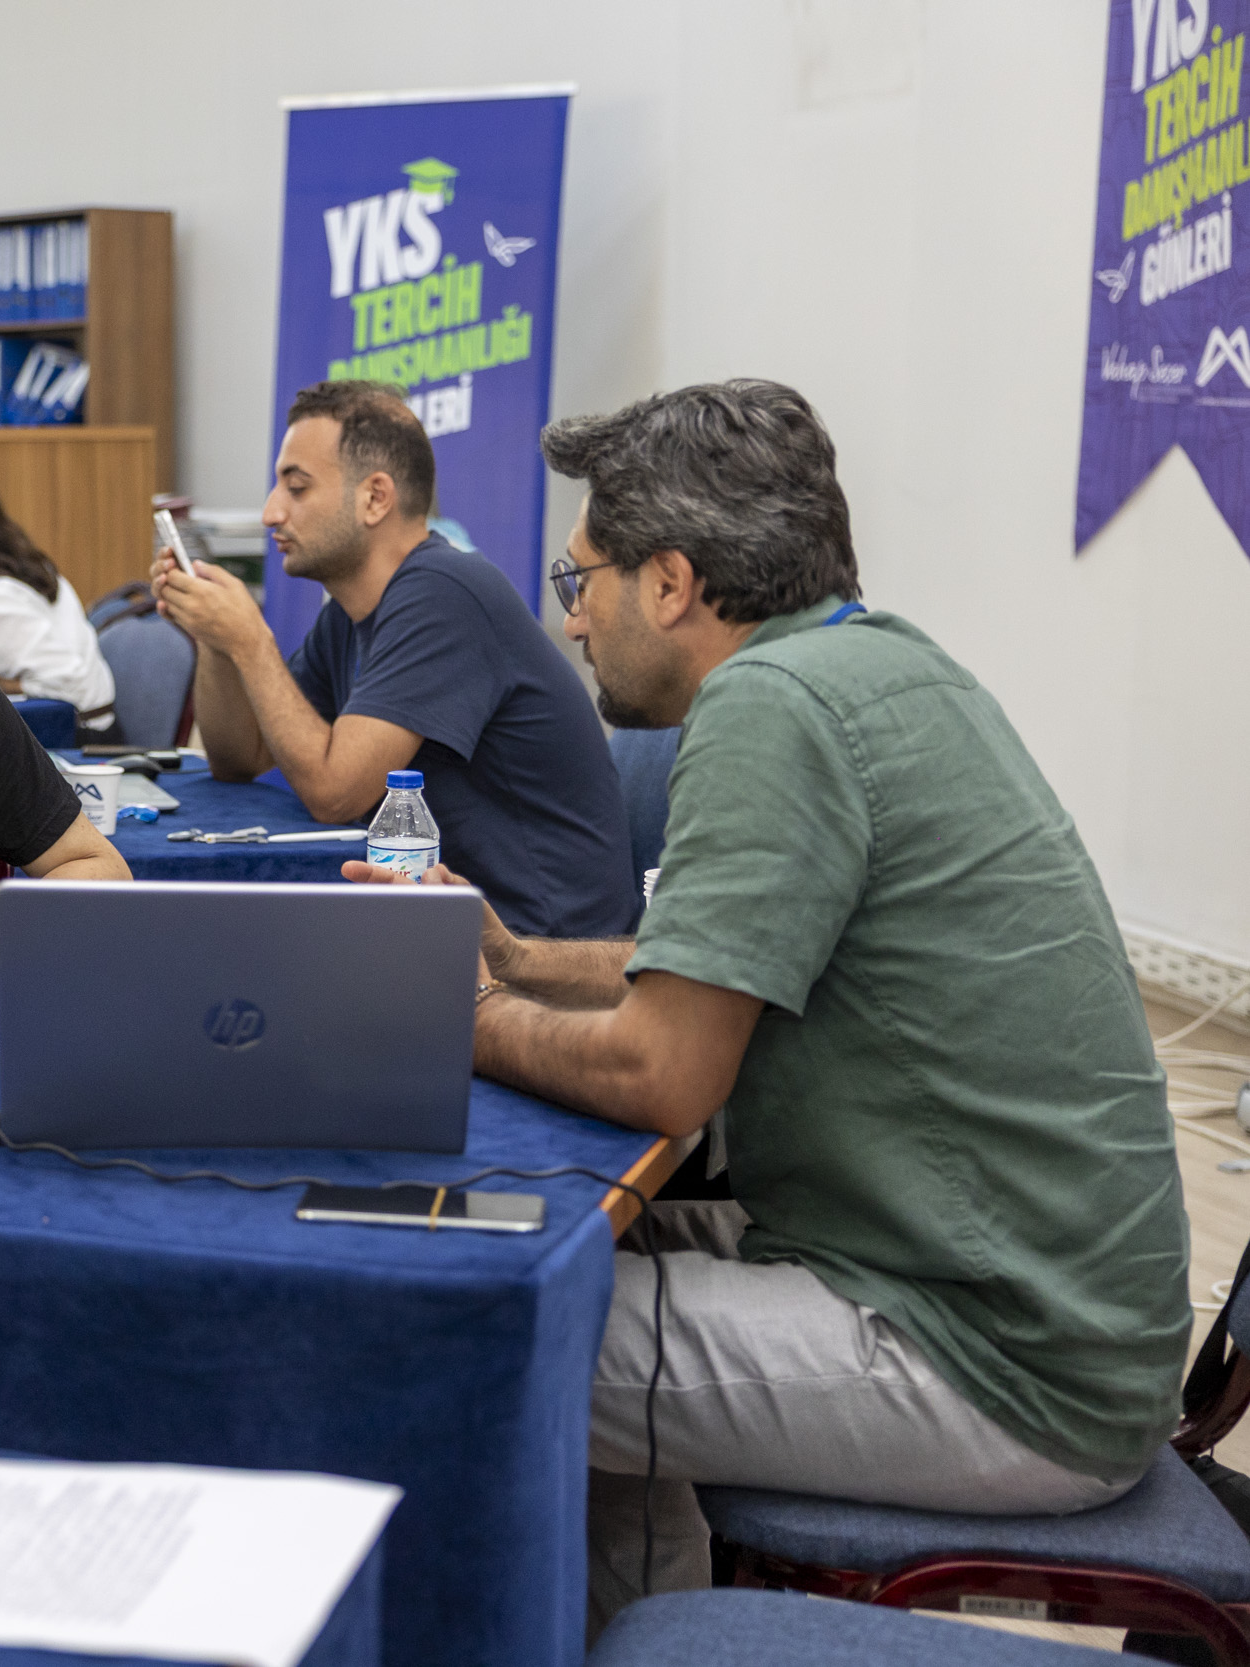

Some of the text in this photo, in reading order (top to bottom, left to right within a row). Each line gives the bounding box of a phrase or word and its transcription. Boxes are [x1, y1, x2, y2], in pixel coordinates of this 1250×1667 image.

[1143, 23, 1246, 165] TERCİH
[1122, 115, 1250, 243] DANIŞMANL
[322, 187, 444, 299] YKS
[1139, 190, 1232, 306] GÜNLERİ
[350, 252, 484, 352] TERCİH
